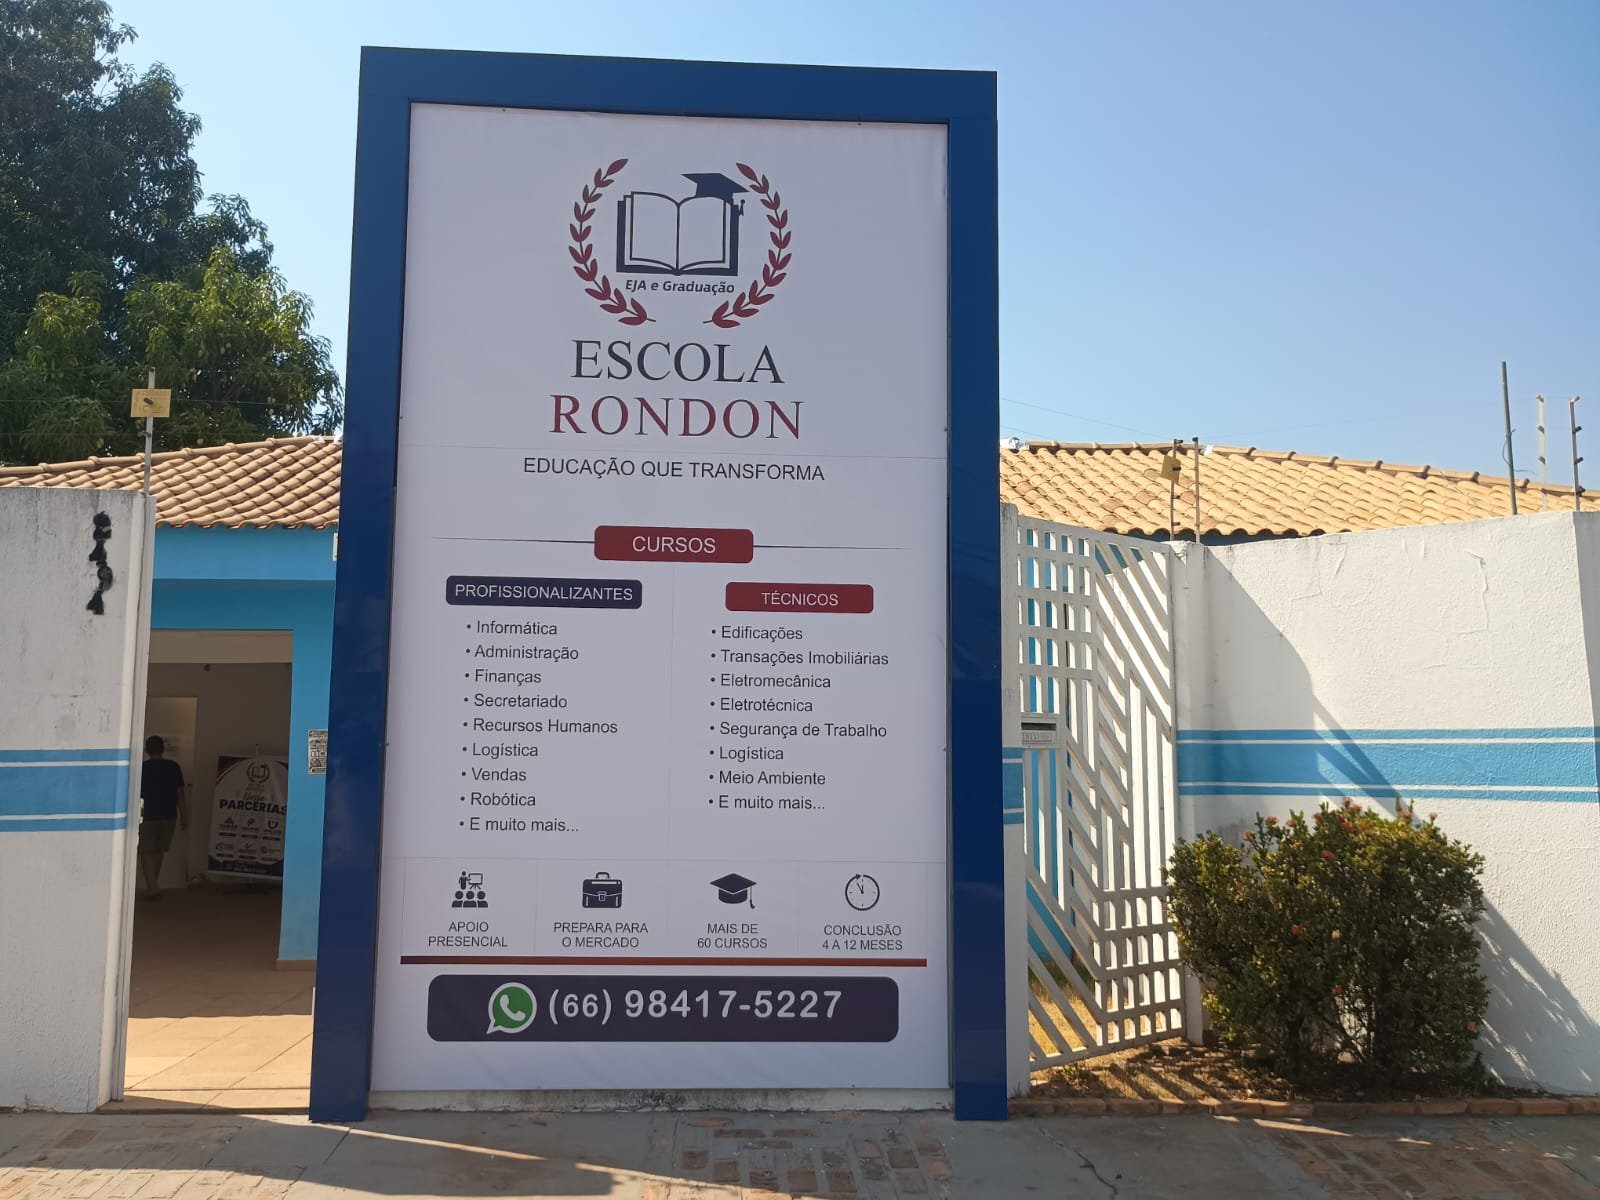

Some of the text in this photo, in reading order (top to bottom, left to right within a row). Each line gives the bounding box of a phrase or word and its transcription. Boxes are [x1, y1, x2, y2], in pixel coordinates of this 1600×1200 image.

[626, 280, 734, 296] EJA e Graduação
[571, 340, 785, 383] ESCOLA
[549, 395, 804, 439] RONDON
[524, 457, 824, 480] EDUCAÇÃO QUE TRANSFORMA
[633, 536, 715, 553] CURSOS
[456, 584, 632, 600] PROFISSIONALIZANTES
[761, 590, 838, 606] TÉCNICOS
[478, 620, 557, 635] Informática
[722, 626, 802, 642] Edificações
[474, 645, 578, 662] Administração
[721, 649, 888, 666] Transações Imobiliárias
[475, 669, 541, 686] Finanças
[721, 674, 830, 688] Eletromecânica
[474, 693, 567, 708] Secretariado
[721, 698, 812, 711] Eletrotécnica
[474, 718, 617, 733] Recursos Humanos
[720, 722, 886, 739] Segurança de Trabalho
[473, 743, 538, 759] Logística
[720, 746, 783, 762] Logística
[472, 768, 526, 781] Vendas
[720, 771, 825, 784] Meio Ambiente
[471, 792, 535, 806] Robótica
[719, 795, 824, 809] E muito mais...
[219, 799, 287, 816] PARCERIAS
[470, 817, 578, 831] E muito mais...
[449, 922, 488, 932] APOIO
[554, 922, 648, 933] PREPARA PARA
[708, 923, 758, 934] MAIS DE
[824, 924, 901, 936] CONCLUSÃO
[429, 936, 508, 947] PRESENCIAL
[562, 937, 639, 948] O MERCADO
[698, 938, 767, 949] 60 CURSOS
[822, 940, 902, 950] 4 A 12 MESES
[549, 989, 841, 1024] (66) 98417-5227
